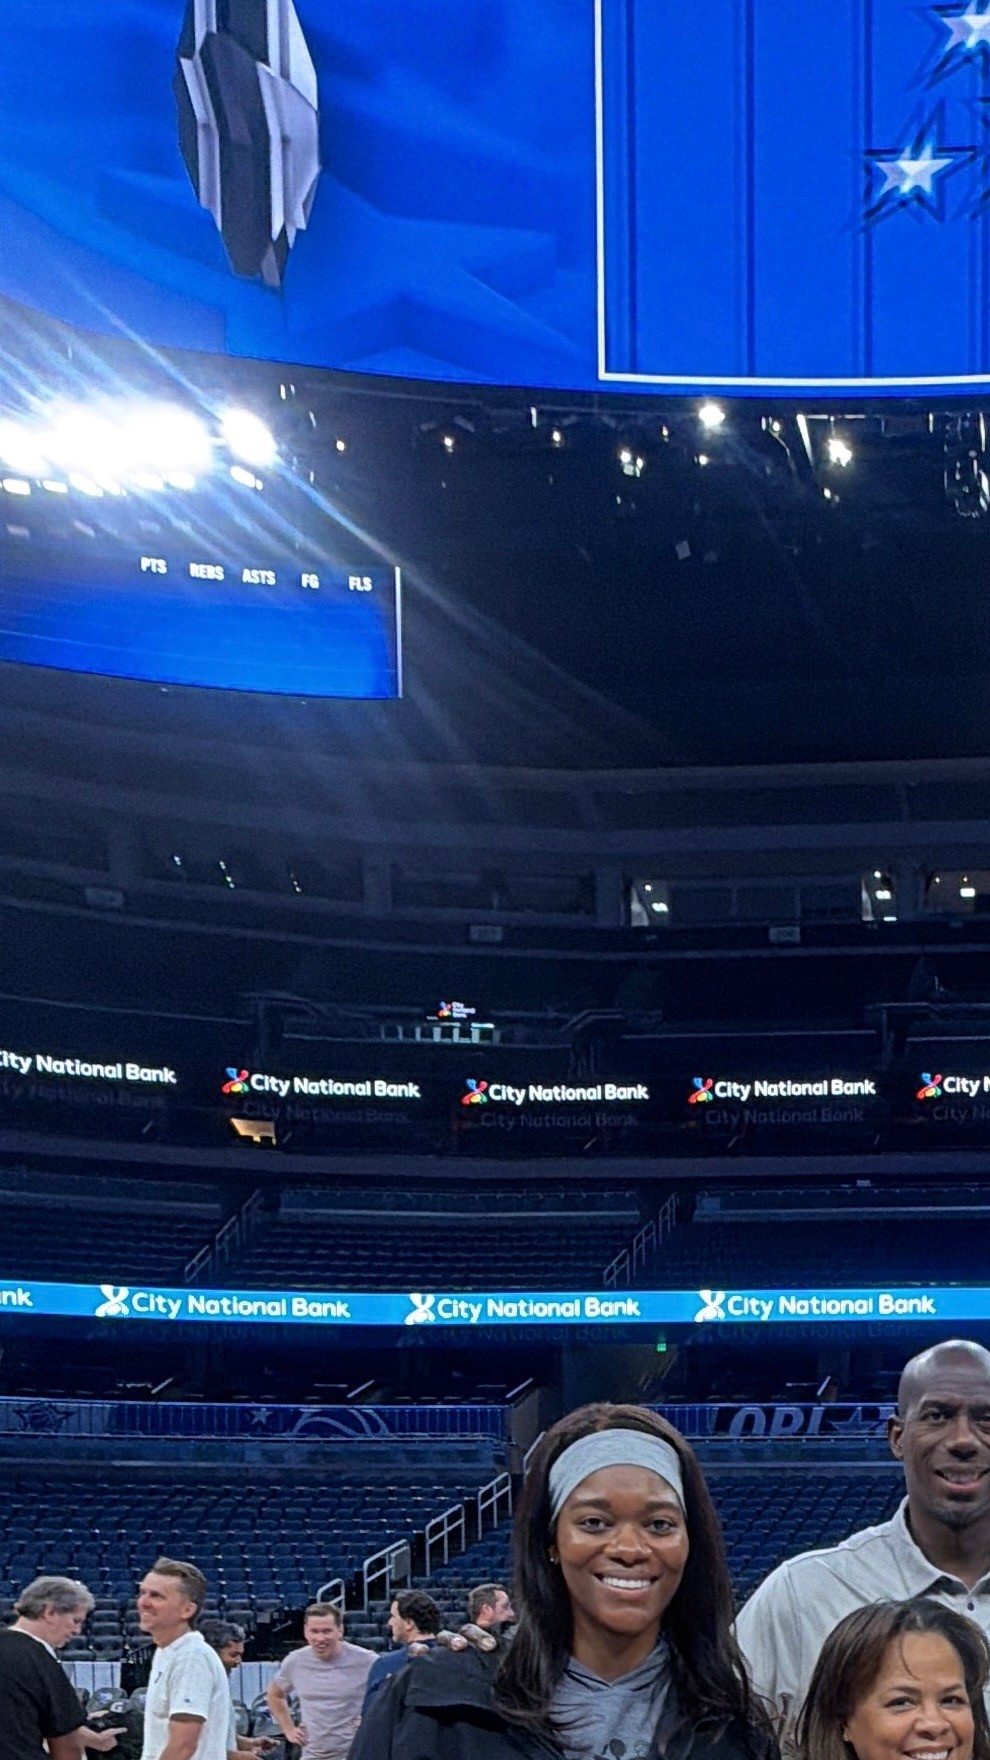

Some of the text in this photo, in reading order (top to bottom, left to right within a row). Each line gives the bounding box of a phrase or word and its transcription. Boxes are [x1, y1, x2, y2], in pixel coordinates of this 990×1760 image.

[140, 556, 373, 592] PTS REBS ASTS FG FLS
[35, 1053, 123, 1080] National
[125, 1061, 178, 1085] Bank
[250, 1073, 421, 1099] City National Bank
[488, 1083, 650, 1107] City National Bank
[714, 1078, 877, 1102] City National Bank
[942, 1075, 981, 1098] City
[131, 1292, 351, 1320] City National Bank
[437, 1297, 641, 1321] City National Bank
[727, 1294, 937, 1321] City National Bank
